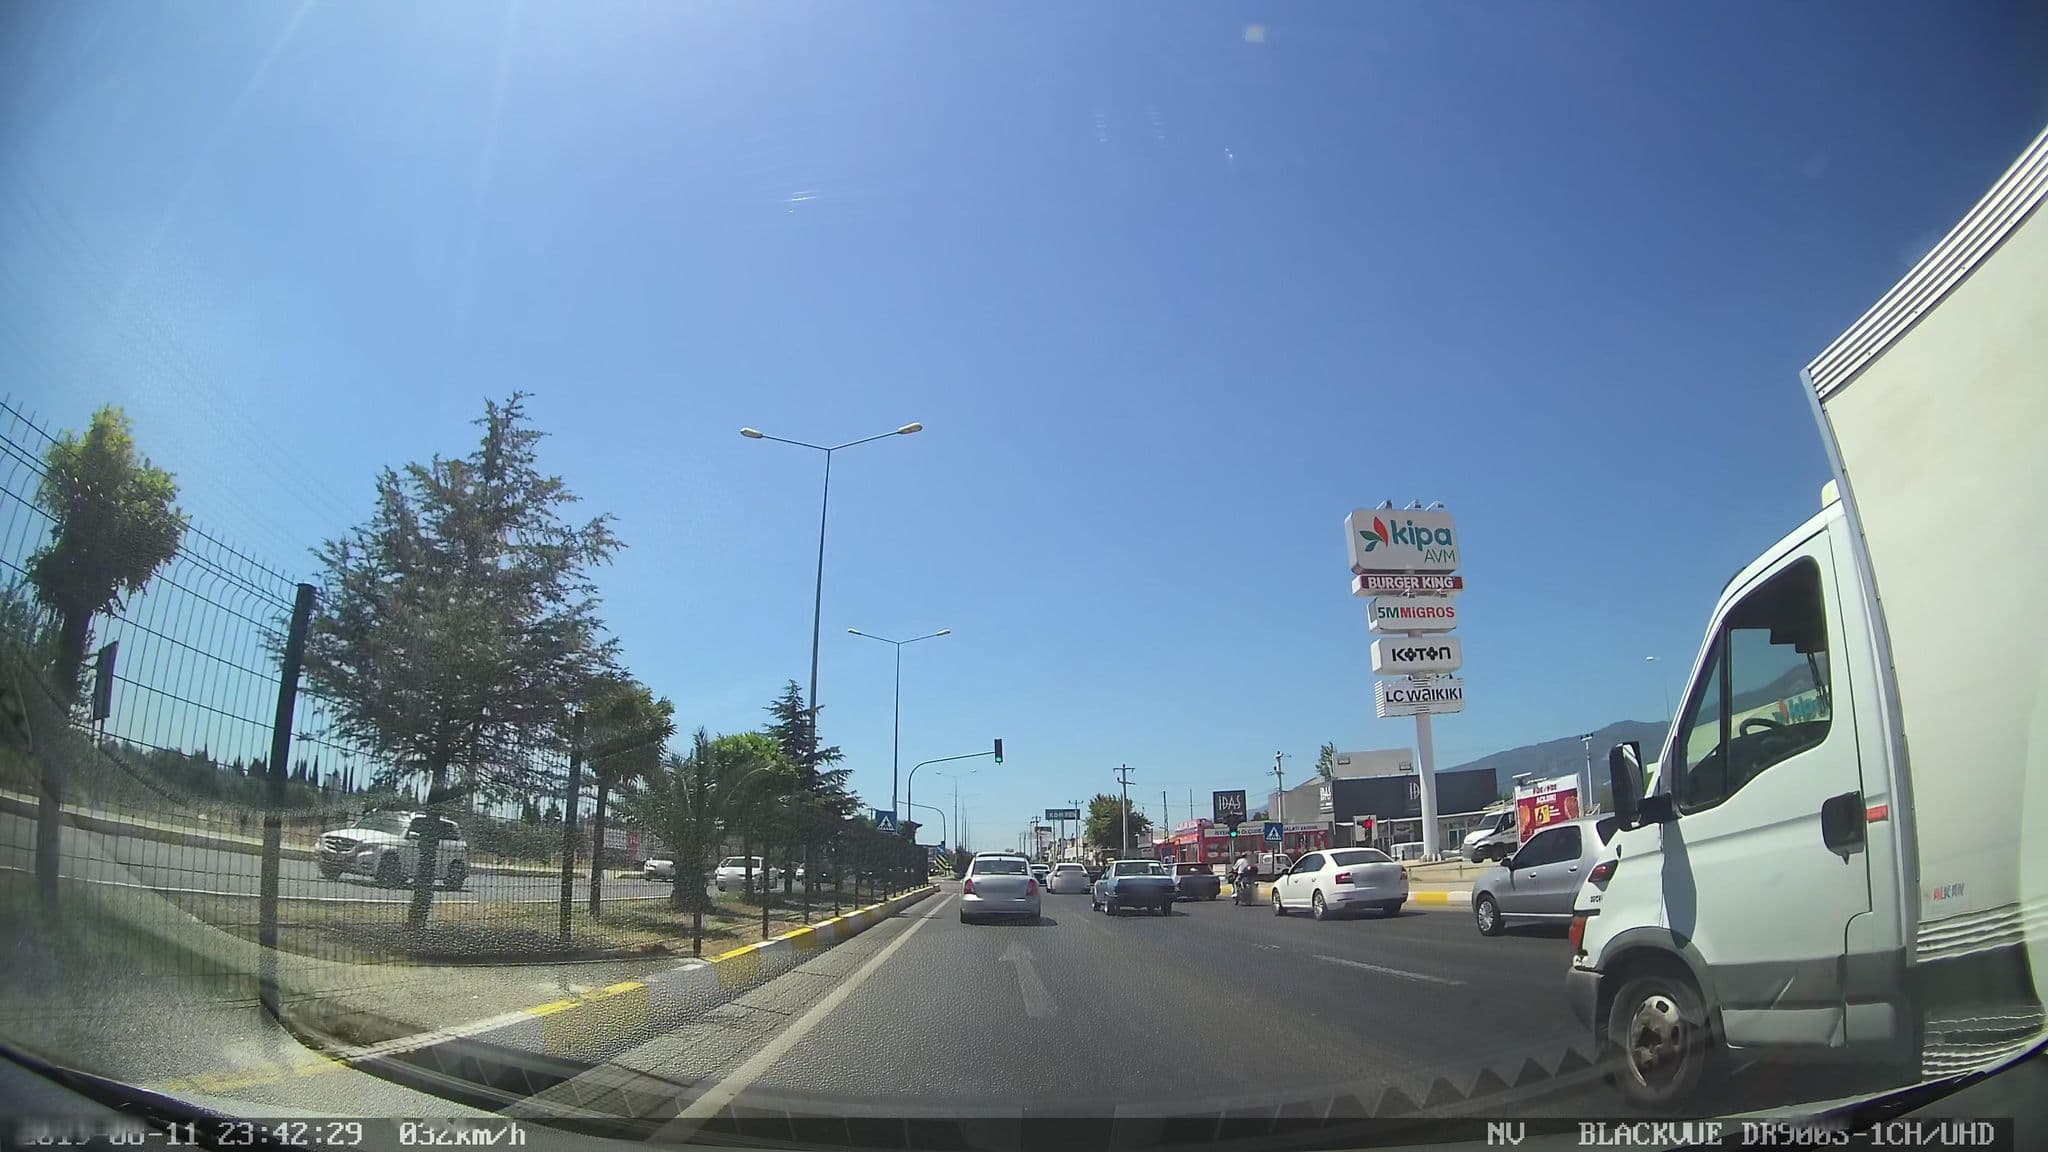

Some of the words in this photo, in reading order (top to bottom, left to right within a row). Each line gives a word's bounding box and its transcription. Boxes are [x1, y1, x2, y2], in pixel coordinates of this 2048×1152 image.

[1391, 519, 1452, 551] kipa
[1424, 549, 1455, 564] AVM
[1368, 575, 1419, 589] BURGER
[1422, 576, 1455, 589] KING
[1386, 689, 1404, 703] LC
